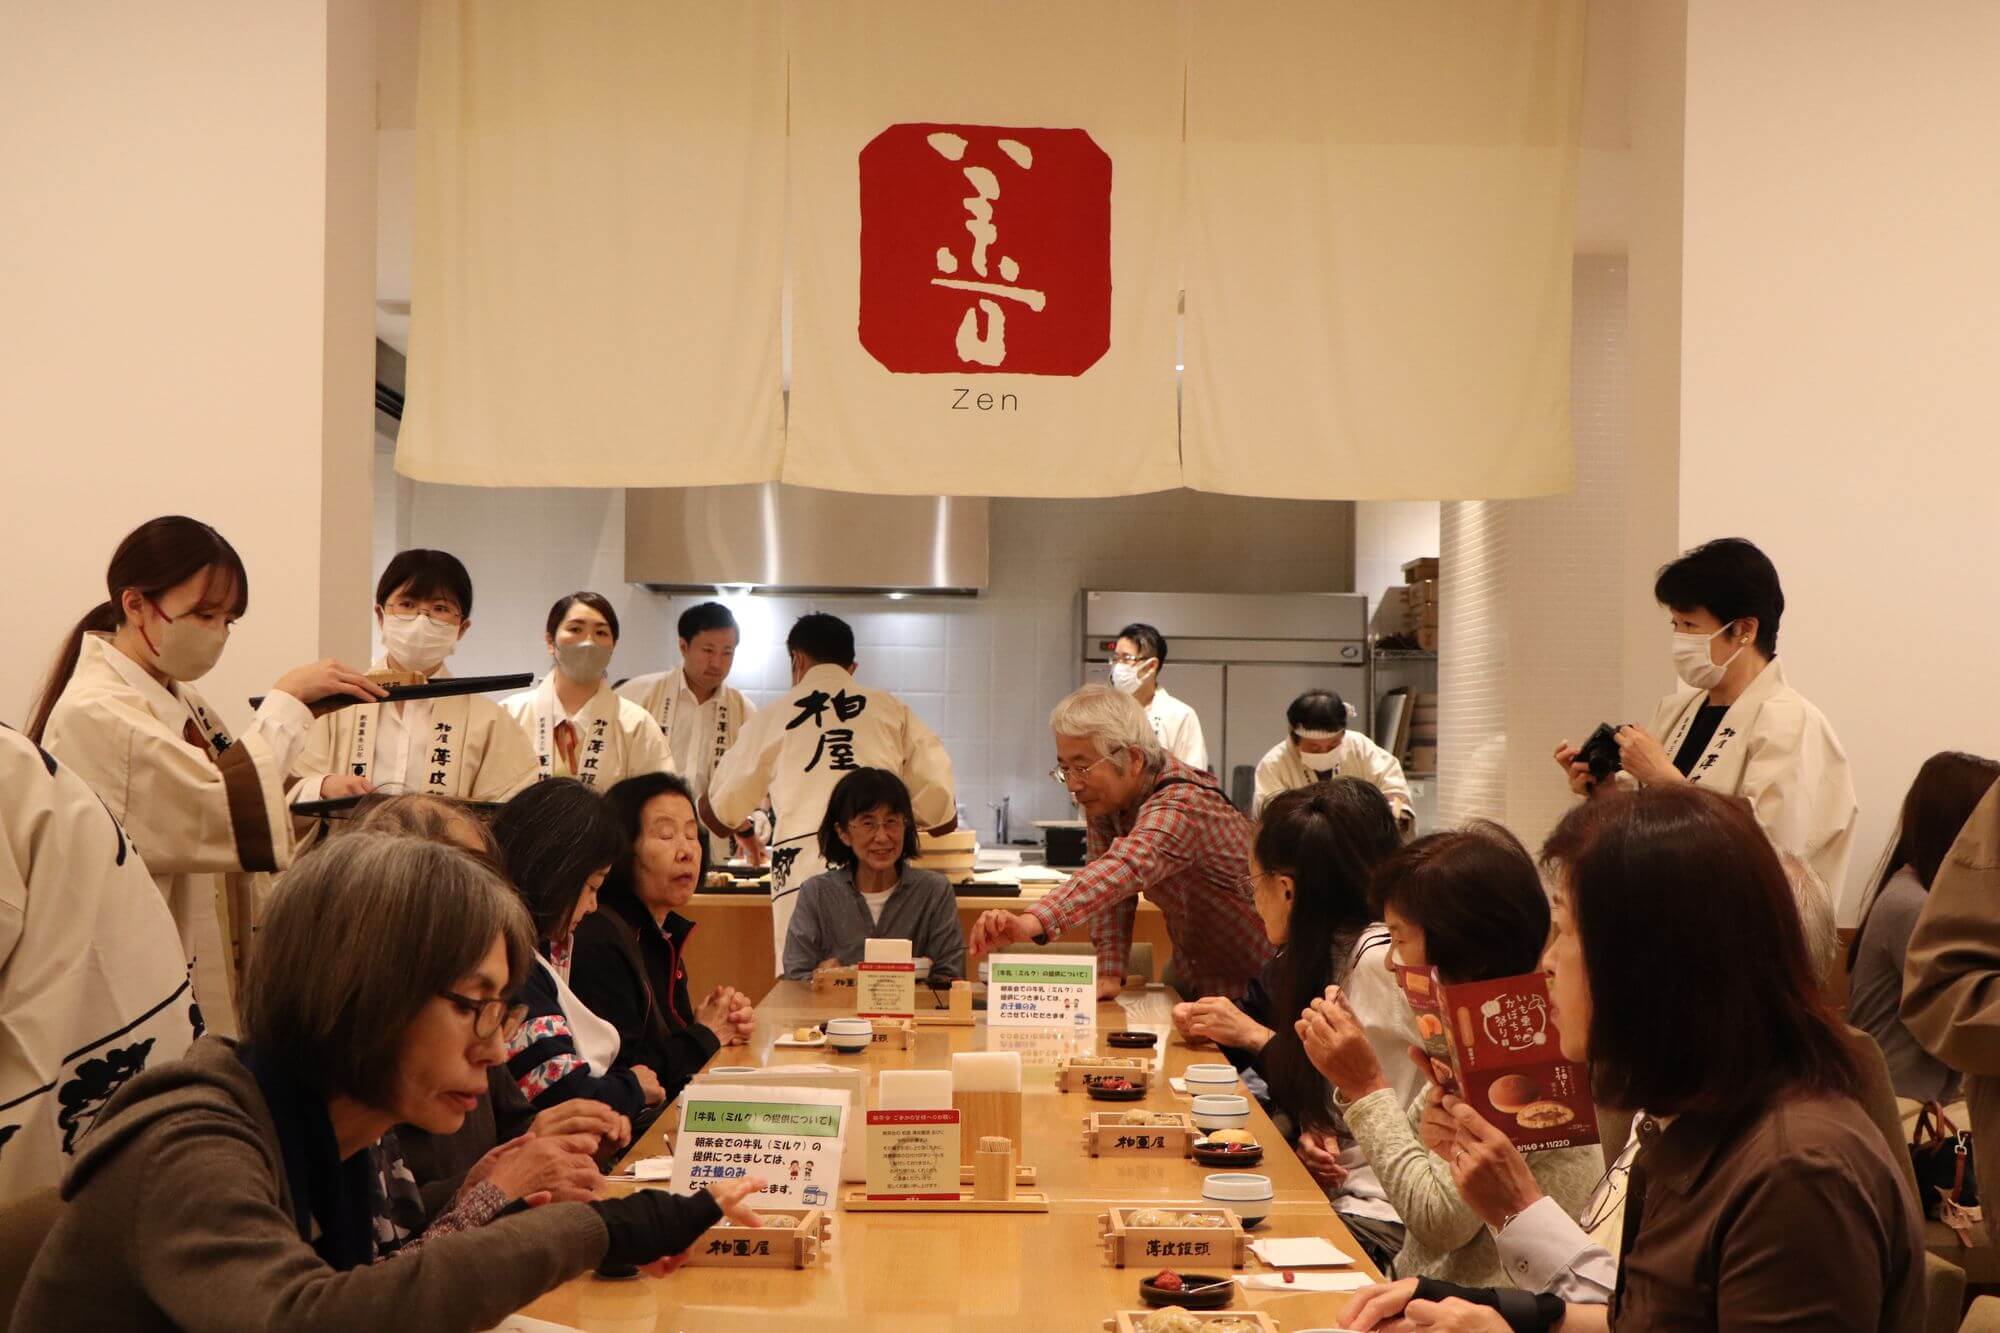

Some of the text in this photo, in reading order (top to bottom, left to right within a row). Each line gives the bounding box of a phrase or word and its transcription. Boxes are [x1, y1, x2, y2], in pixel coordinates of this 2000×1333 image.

[951, 388, 1018, 411] Zen
[786, 688, 867, 772] 柏屋
[1000, 1002, 1037, 1010] お子様のみ
[692, 1152, 786, 1166] 提供につきましては、
[690, 1165, 747, 1179] お子様のみ
[1146, 1239, 1211, 1257] 薄皮饅頭
